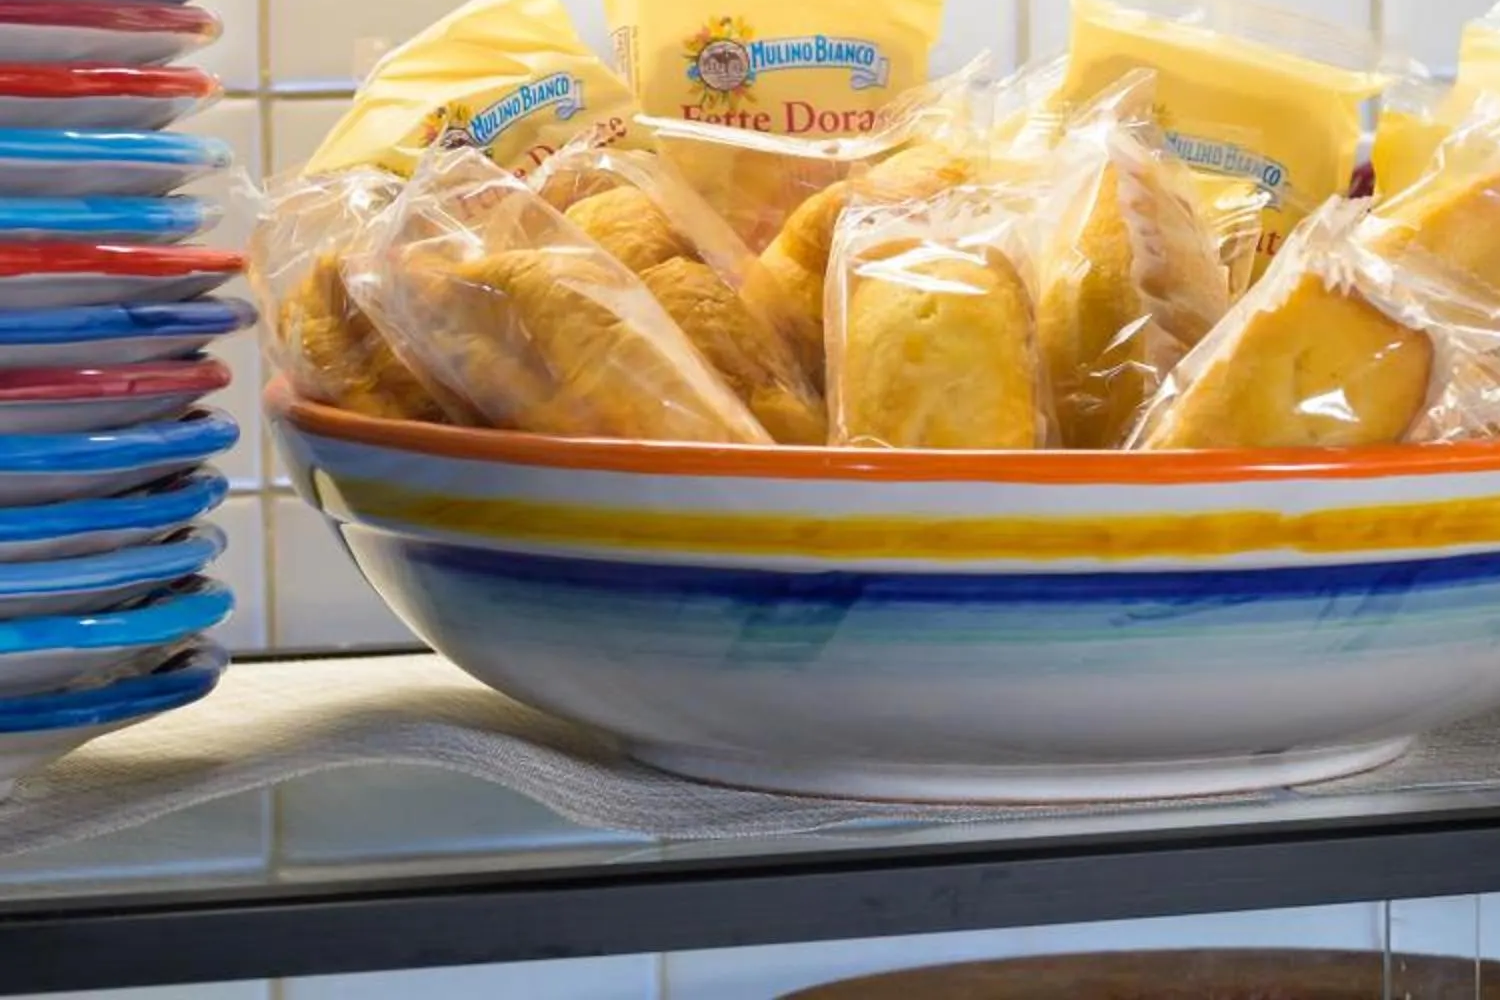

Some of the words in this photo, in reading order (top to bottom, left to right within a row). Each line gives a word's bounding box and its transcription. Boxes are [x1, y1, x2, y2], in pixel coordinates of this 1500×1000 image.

[751, 40, 810, 68] MULINO
[814, 34, 875, 66] BIANCO
[471, 100, 521, 144] MULINO
[519, 76, 569, 112] BIANCO
